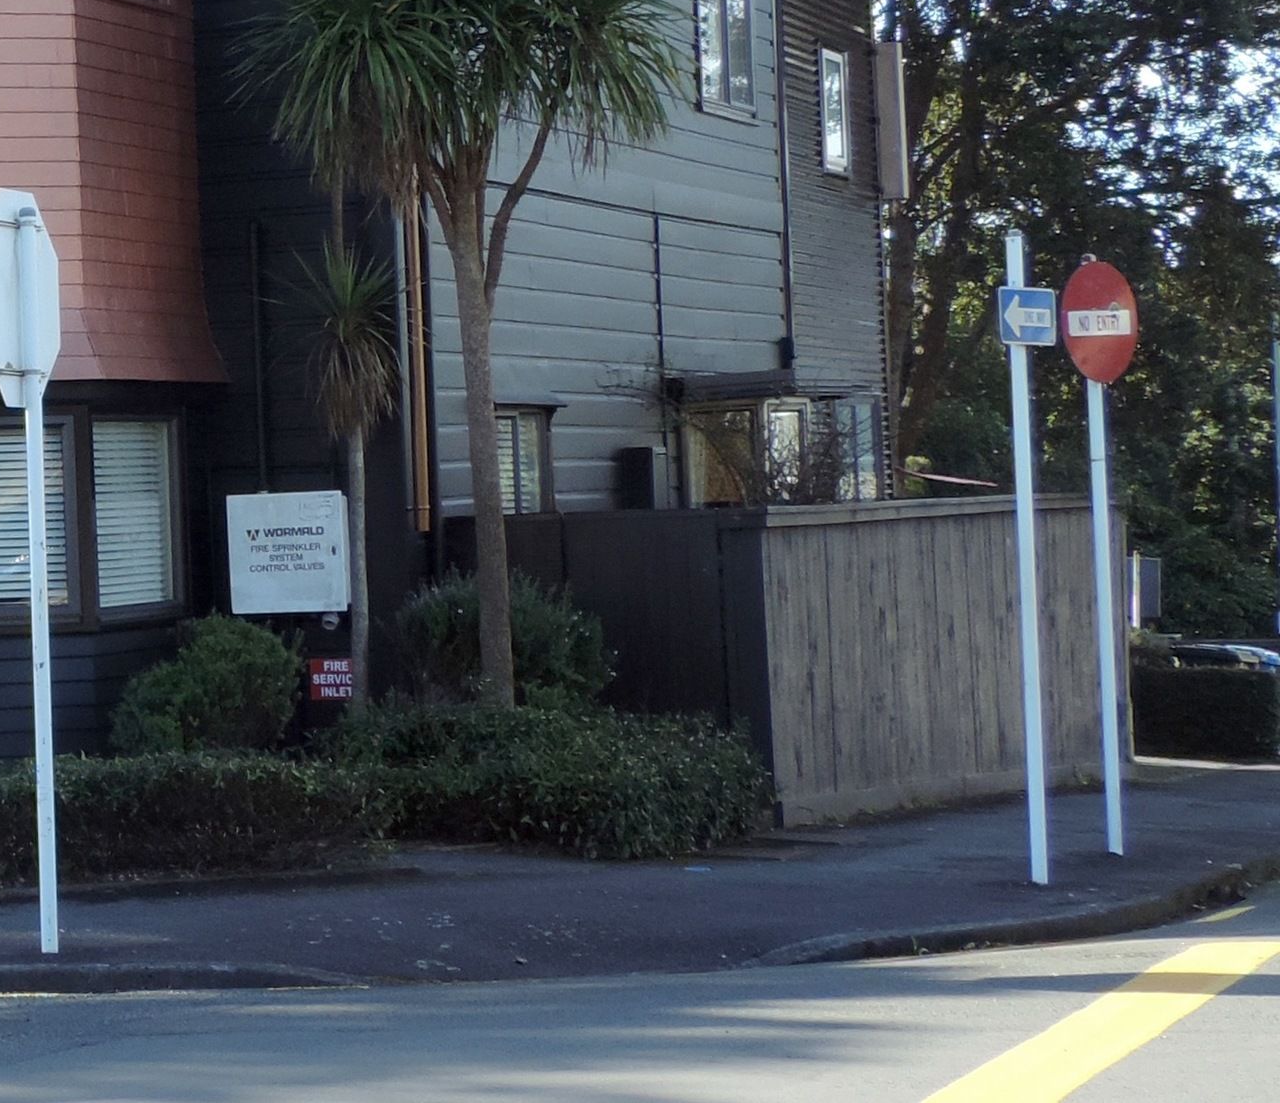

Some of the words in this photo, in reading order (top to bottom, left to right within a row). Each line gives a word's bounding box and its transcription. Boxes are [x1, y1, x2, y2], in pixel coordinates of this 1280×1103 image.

[1078, 315, 1090, 331] NO
[1096, 314, 1120, 331] ENTRY
[263, 526, 325, 537] WORMALD
[250, 544, 269, 553] FIRE
[272, 542, 321, 552] SPRINKLER
[269, 554, 303, 562] SYSTEM
[249, 563, 291, 573] CONTROL
[293, 562, 325, 571] VALVES
[323, 661, 349, 672] FIRE
[312, 673, 352, 685] SERVIC
[321, 686, 352, 697] INLET
